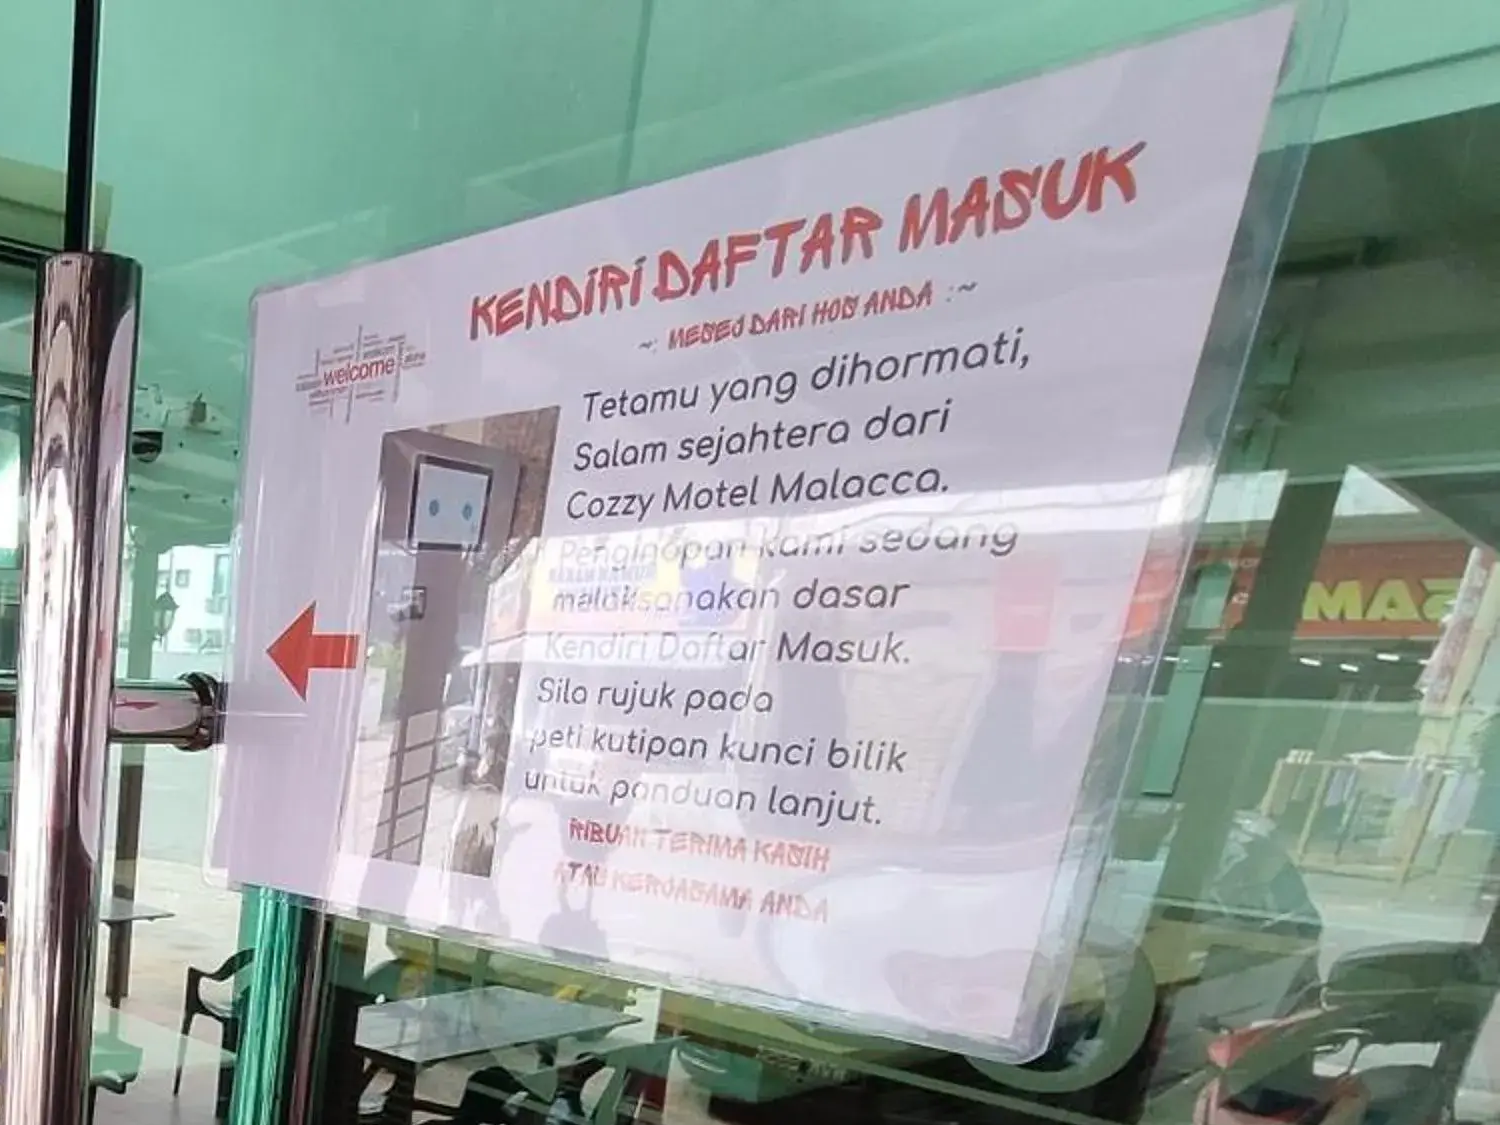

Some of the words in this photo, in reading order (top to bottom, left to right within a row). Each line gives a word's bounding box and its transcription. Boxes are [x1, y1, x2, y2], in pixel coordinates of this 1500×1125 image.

[470, 255, 647, 341] KENDIRI
[652, 206, 884, 302] DAFTAR
[899, 141, 1148, 253] MASUK
[749, 304, 808, 336] DARI
[863, 280, 934, 318] ANDA
[323, 356, 396, 387] welcome
[583, 383, 700, 422] Tetamu
[710, 370, 798, 414] yang
[810, 326, 1030, 391] dihormati,
[573, 438, 668, 472] Salam
[676, 420, 851, 466] sejahtera
[863, 397, 953, 440] dari
[566, 489, 655, 522] Cozzy
[662, 474, 760, 513] Motel
[770, 466, 950, 505] Malacca.
[759, 526, 849, 557] kami
[858, 517, 1020, 558] sedang
[792, 577, 911, 609] dasar
[544, 630, 648, 661] Kendiri
[657, 630, 767, 662] Daftar
[776, 630, 911, 664] Masuk.
[537, 676, 588, 705] Sila
[596, 680, 676, 715] rujuk
[684, 684, 773, 717] pada
[529, 724, 584, 753] peti
[592, 726, 708, 763] kutipan
[718, 732, 817, 766] kunci
[826, 737, 909, 773] bilik
[524, 769, 601, 797] untuk
[609, 777, 756, 812] panduan
[767, 784, 882, 828] lanjut.
[652, 828, 747, 863] TERIMA
